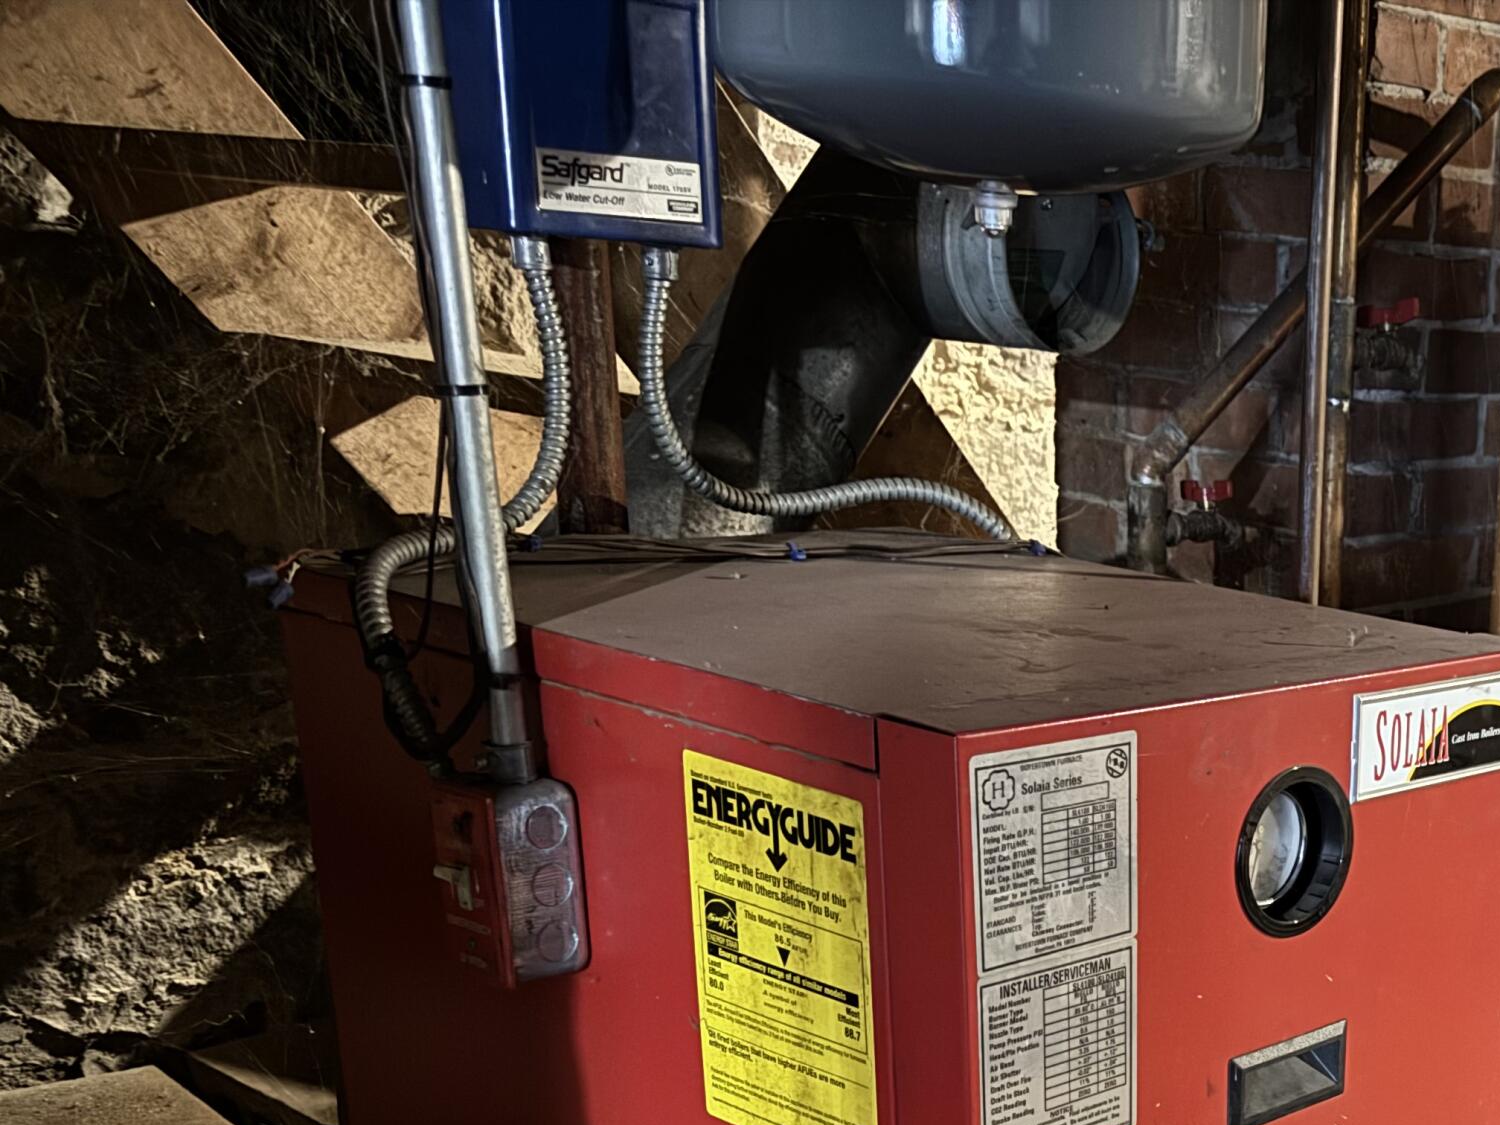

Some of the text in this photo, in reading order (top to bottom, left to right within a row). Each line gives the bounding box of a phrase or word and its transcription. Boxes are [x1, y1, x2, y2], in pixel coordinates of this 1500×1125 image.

[542, 155, 624, 186] Safgard
[648, 183, 670, 192] MODEL
[544, 190, 625, 205] Low Water Cut-Off
[1374, 705, 1449, 781] SOLAIA
[1451, 727, 1500, 744] Cast Iron Boilers
[991, 781, 1004, 800] H
[1021, 773, 1082, 795] Solaia Series
[691, 778, 856, 864] ENERGYGUIDE
[982, 823, 1006, 834] MODEL:
[983, 835, 999, 846] Firing
[1002, 832, 1015, 841] Rate
[983, 846, 999, 856] Input
[984, 856, 996, 866] DOE
[984, 867, 995, 875] Net
[997, 864, 1010, 872] Rate
[708, 852, 846, 908] Compare the Energy Efficiency of this
[1012, 880, 1028, 890] Water
[714, 870, 735, 886] Boiler
[738, 879, 753, 892] with
[780, 892, 806, 910] Before
[808, 901, 822, 914] You
[825, 906, 841, 923] Buy.
[744, 910, 812, 943] This Model's Efficiency
[986, 916, 1016, 929] STANDARD
[986, 924, 1022, 939] CLEARANCES
[1015, 925, 1093, 951] BOYERTOWN FURNACE COMPANY
[1031, 926, 1054, 938] Chimney
[775, 934, 790, 946] 86.5
[708, 957, 721, 968] Least
[718, 948, 737, 963] Energy
[739, 954, 766, 973] efficiency
[786, 972, 792, 981] of
[709, 967, 729, 980] Efficient
[999, 957, 1110, 1000] INSTALLER/SERVICEMAN
[709, 977, 724, 991] 80.0
[763, 978, 787, 992] ENERGY
[769, 991, 790, 1004] symbol
[988, 1002, 1007, 1014] Model
[1008, 996, 1031, 1008] Number
[764, 1002, 784, 1013] energy
[846, 1007, 860, 1019] Most
[989, 1007, 1023, 1023] Burner Type
[837, 1013, 861, 1028] Efficient
[989, 1013, 1028, 1030] Burner Model
[989, 1024, 1023, 1040] Nozzle Type
[709, 1040, 727, 1052] energy
[989, 1040, 1005, 1051] Pump
[1007, 1032, 1031, 1046] Pressure
[1016, 1041, 1039, 1053] Position
[717, 1032, 730, 1043] fired
[731, 1037, 750, 1050] boilers
[751, 1045, 762, 1056] that
[763, 1050, 776, 1062] have
[778, 1055, 796, 1071] higher
[798, 1062, 817, 1078] AFUEs
[819, 1072, 828, 1082] are
[830, 1076, 846, 1089] more
[990, 1064, 998, 1072] Air
[990, 1068, 1020, 1083] Air Shutter
[990, 1075, 1031, 1094] Draft Over Fire
[991, 1095, 1005, 1105] Draft
[1014, 1087, 1029, 1097] Stack
[1003, 1098, 1026, 1112] Reading
[1050, 1105, 1073, 1118] NOTICE
[1012, 1107, 1034, 1121] Reading
